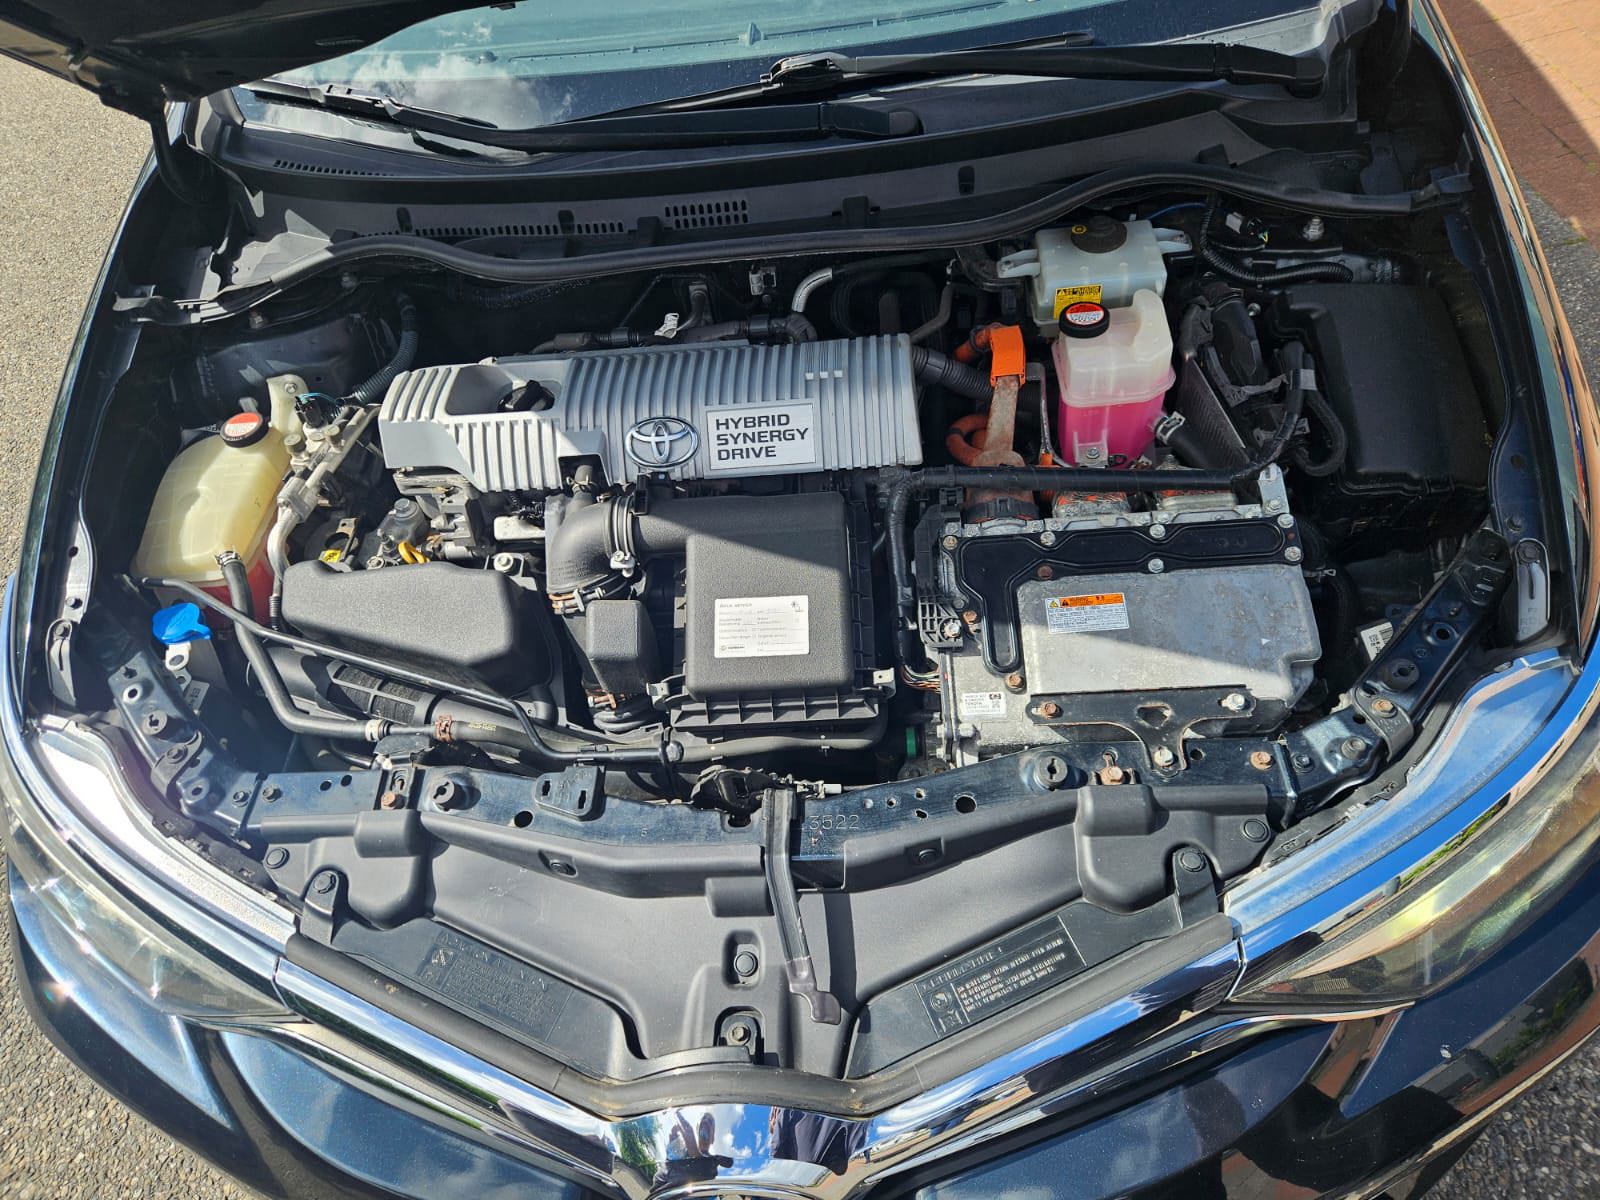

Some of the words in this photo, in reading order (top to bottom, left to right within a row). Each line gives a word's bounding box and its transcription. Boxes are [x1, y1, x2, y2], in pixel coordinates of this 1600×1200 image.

[716, 413, 790, 431] HYBRID
[716, 427, 809, 446] SYNERGY
[717, 445, 776, 461] DRIVE
[809, 814, 859, 830] 3522
